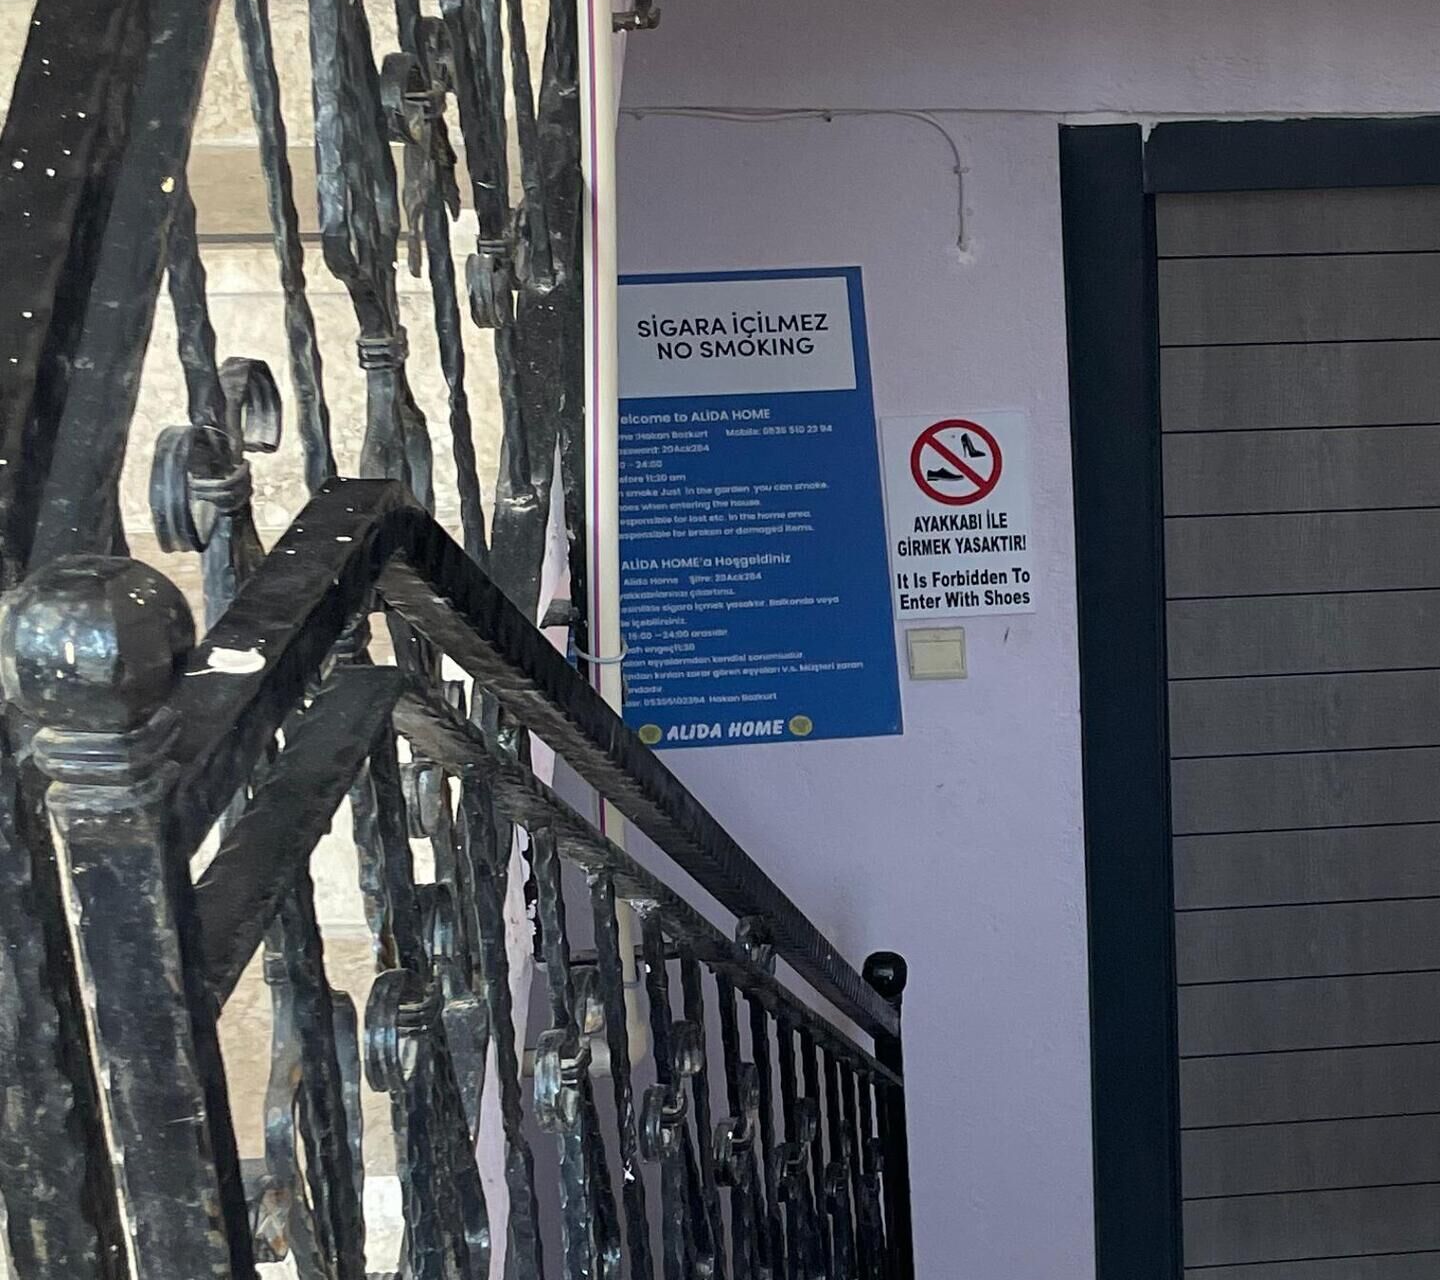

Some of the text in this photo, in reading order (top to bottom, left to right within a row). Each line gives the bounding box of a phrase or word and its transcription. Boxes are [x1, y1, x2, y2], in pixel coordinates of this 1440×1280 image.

[637, 311, 828, 338] SİGARA İÇİLMEZ
[657, 337, 814, 359] NO SMOKING
[620, 409, 770, 424] elcome to ALİDA HOME
[619, 474, 643, 483] efore
[697, 487, 712, 495] the
[619, 516, 672, 527] esponsible
[914, 509, 1008, 533] AYAKKABI İLE
[619, 530, 671, 541] esponsible
[897, 535, 1026, 556] GİRMEK YASAKTIR!
[622, 559, 658, 571] ALİDA
[897, 568, 1030, 589] It Is Forbidden To
[900, 590, 1030, 610] Enter With Shoes
[666, 720, 784, 741] ALIDA HOME
